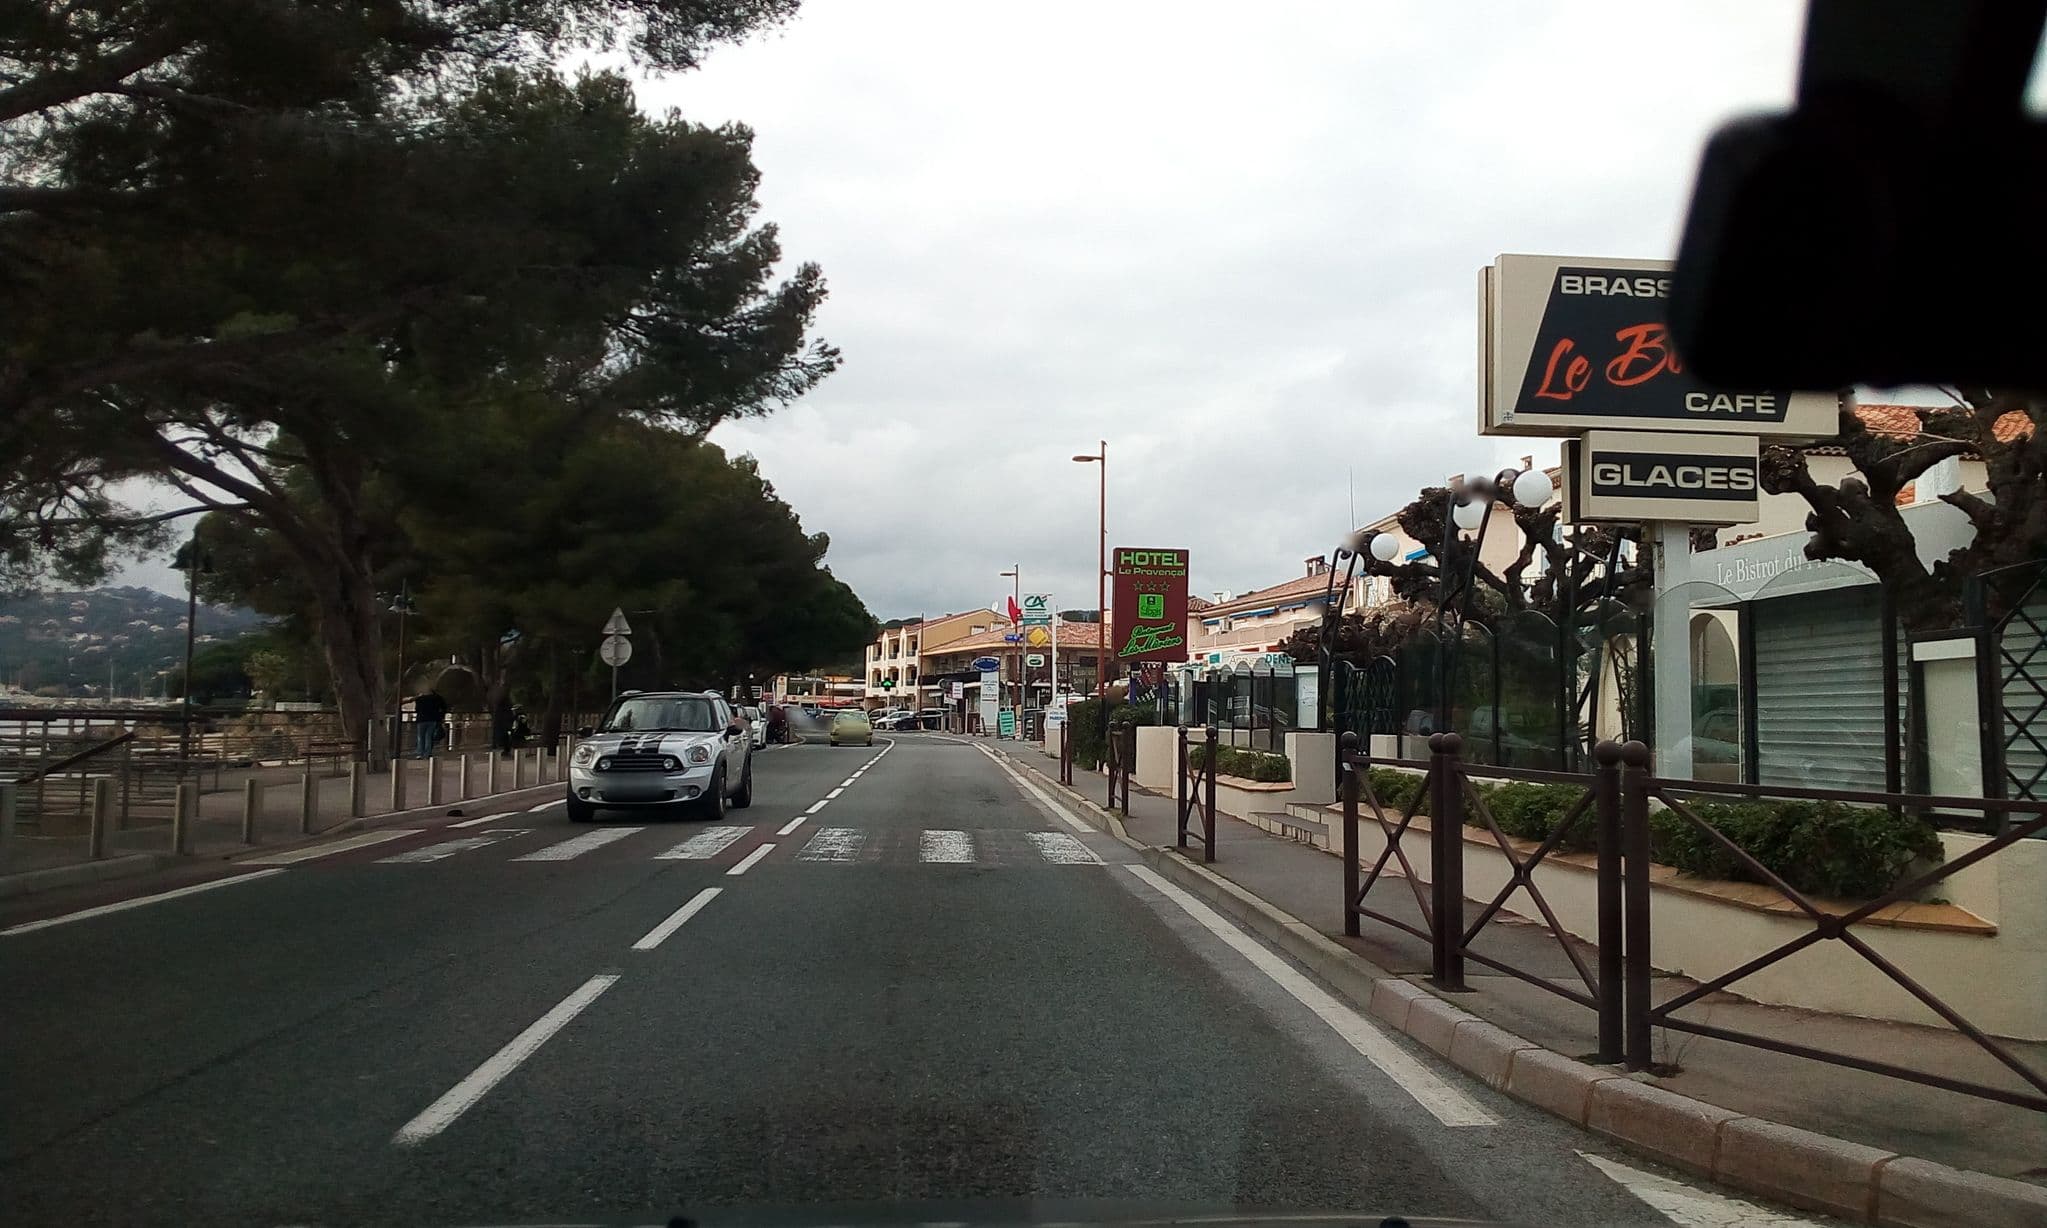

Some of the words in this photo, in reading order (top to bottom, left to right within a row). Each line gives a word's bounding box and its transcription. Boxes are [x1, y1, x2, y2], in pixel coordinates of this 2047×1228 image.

[1536, 338, 1593, 400] Le
[1592, 463, 1755, 491] GLACES
[1120, 552, 1184, 566] HOTEL
[1717, 562, 1733, 586] Le
[1736, 557, 1780, 583] Bistrot
[1784, 549, 1802, 573] du
